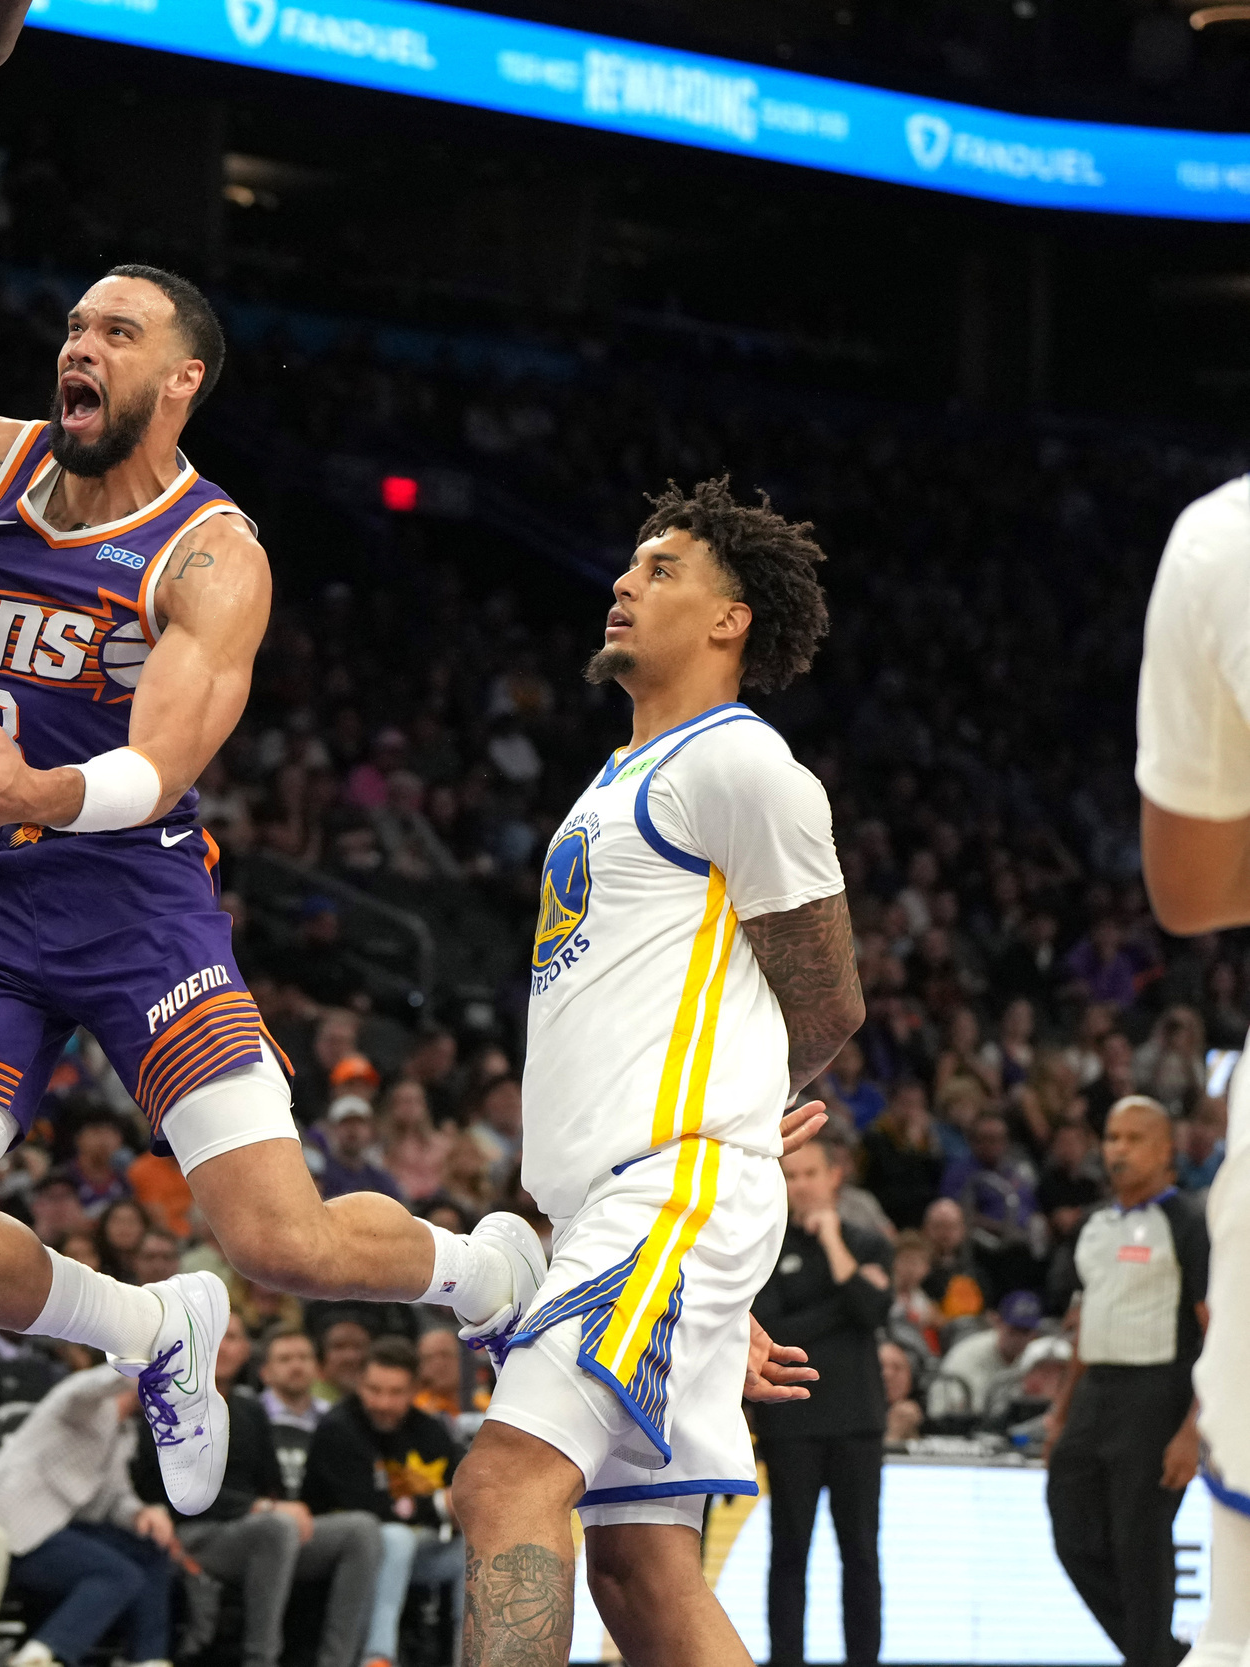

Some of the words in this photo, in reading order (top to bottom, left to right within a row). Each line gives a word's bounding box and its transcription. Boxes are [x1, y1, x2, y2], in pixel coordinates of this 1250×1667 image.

[96, 544, 145, 569] paze
[532, 933, 591, 997] RRIORS
[146, 964, 233, 1036] PHOENIX
